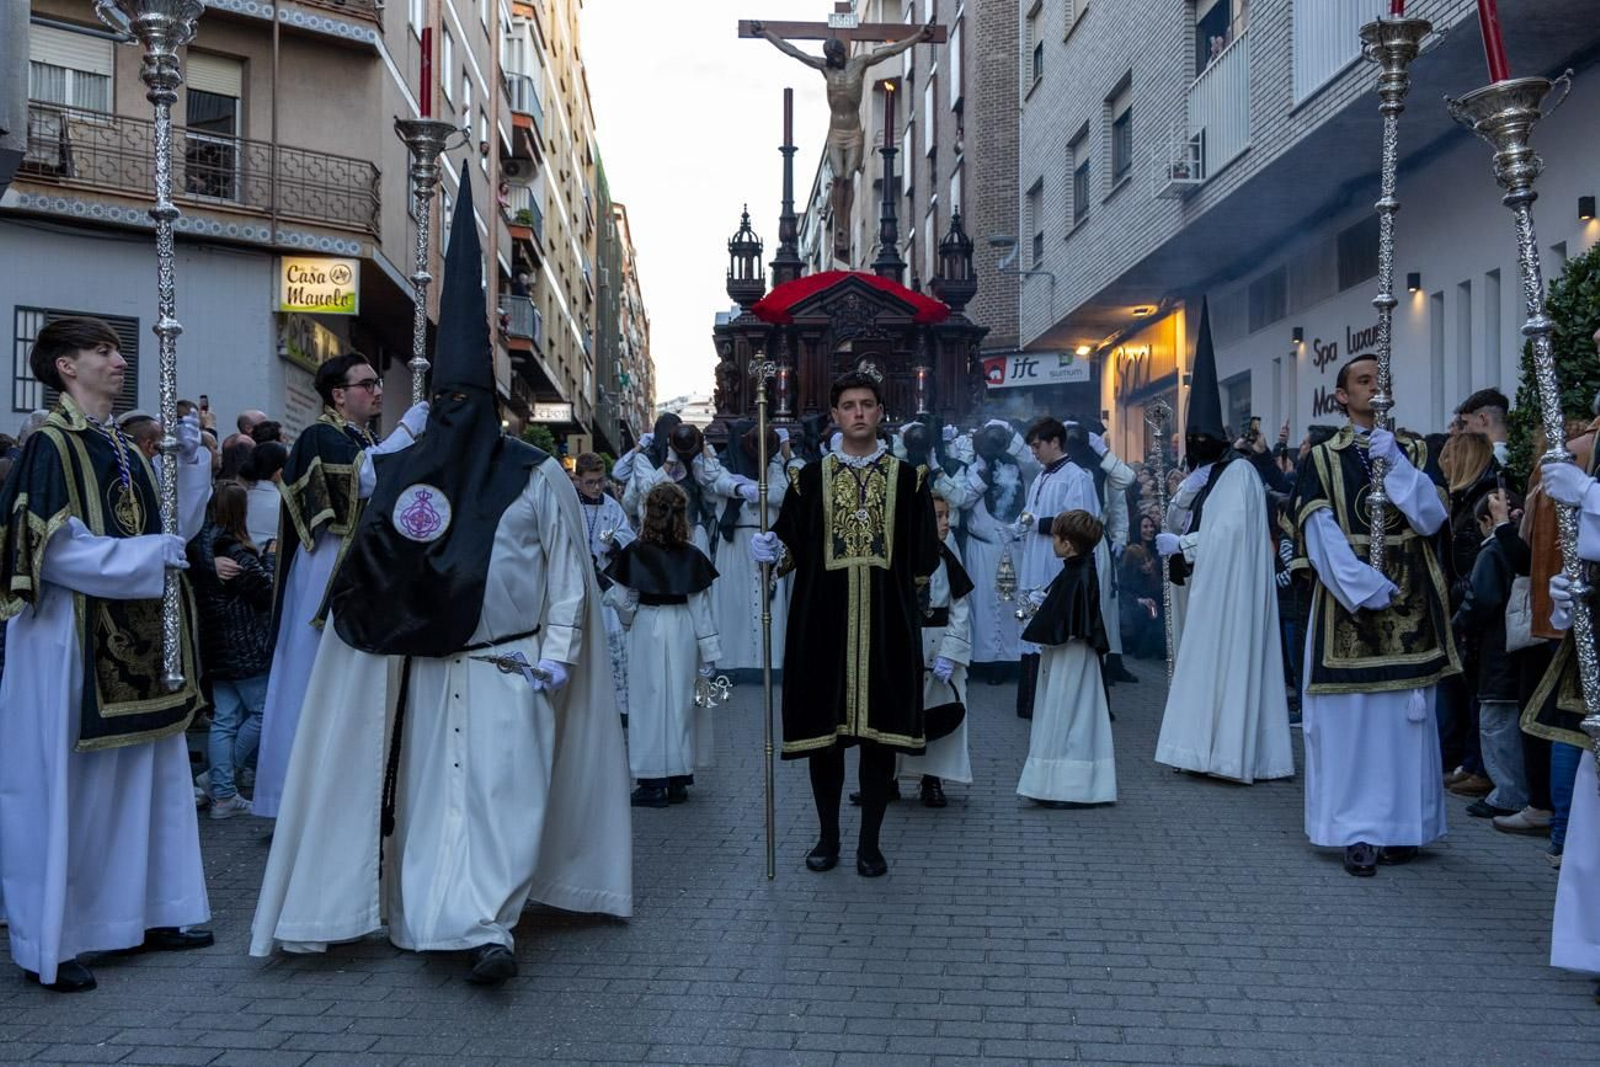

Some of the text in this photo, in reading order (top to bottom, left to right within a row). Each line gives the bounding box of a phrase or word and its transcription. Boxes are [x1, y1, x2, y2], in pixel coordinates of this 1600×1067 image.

[287, 264, 326, 284] Casa
[287, 286, 349, 307] Manolo
[1313, 338, 1338, 374] Spa
[1011, 357, 1040, 379] jfc
